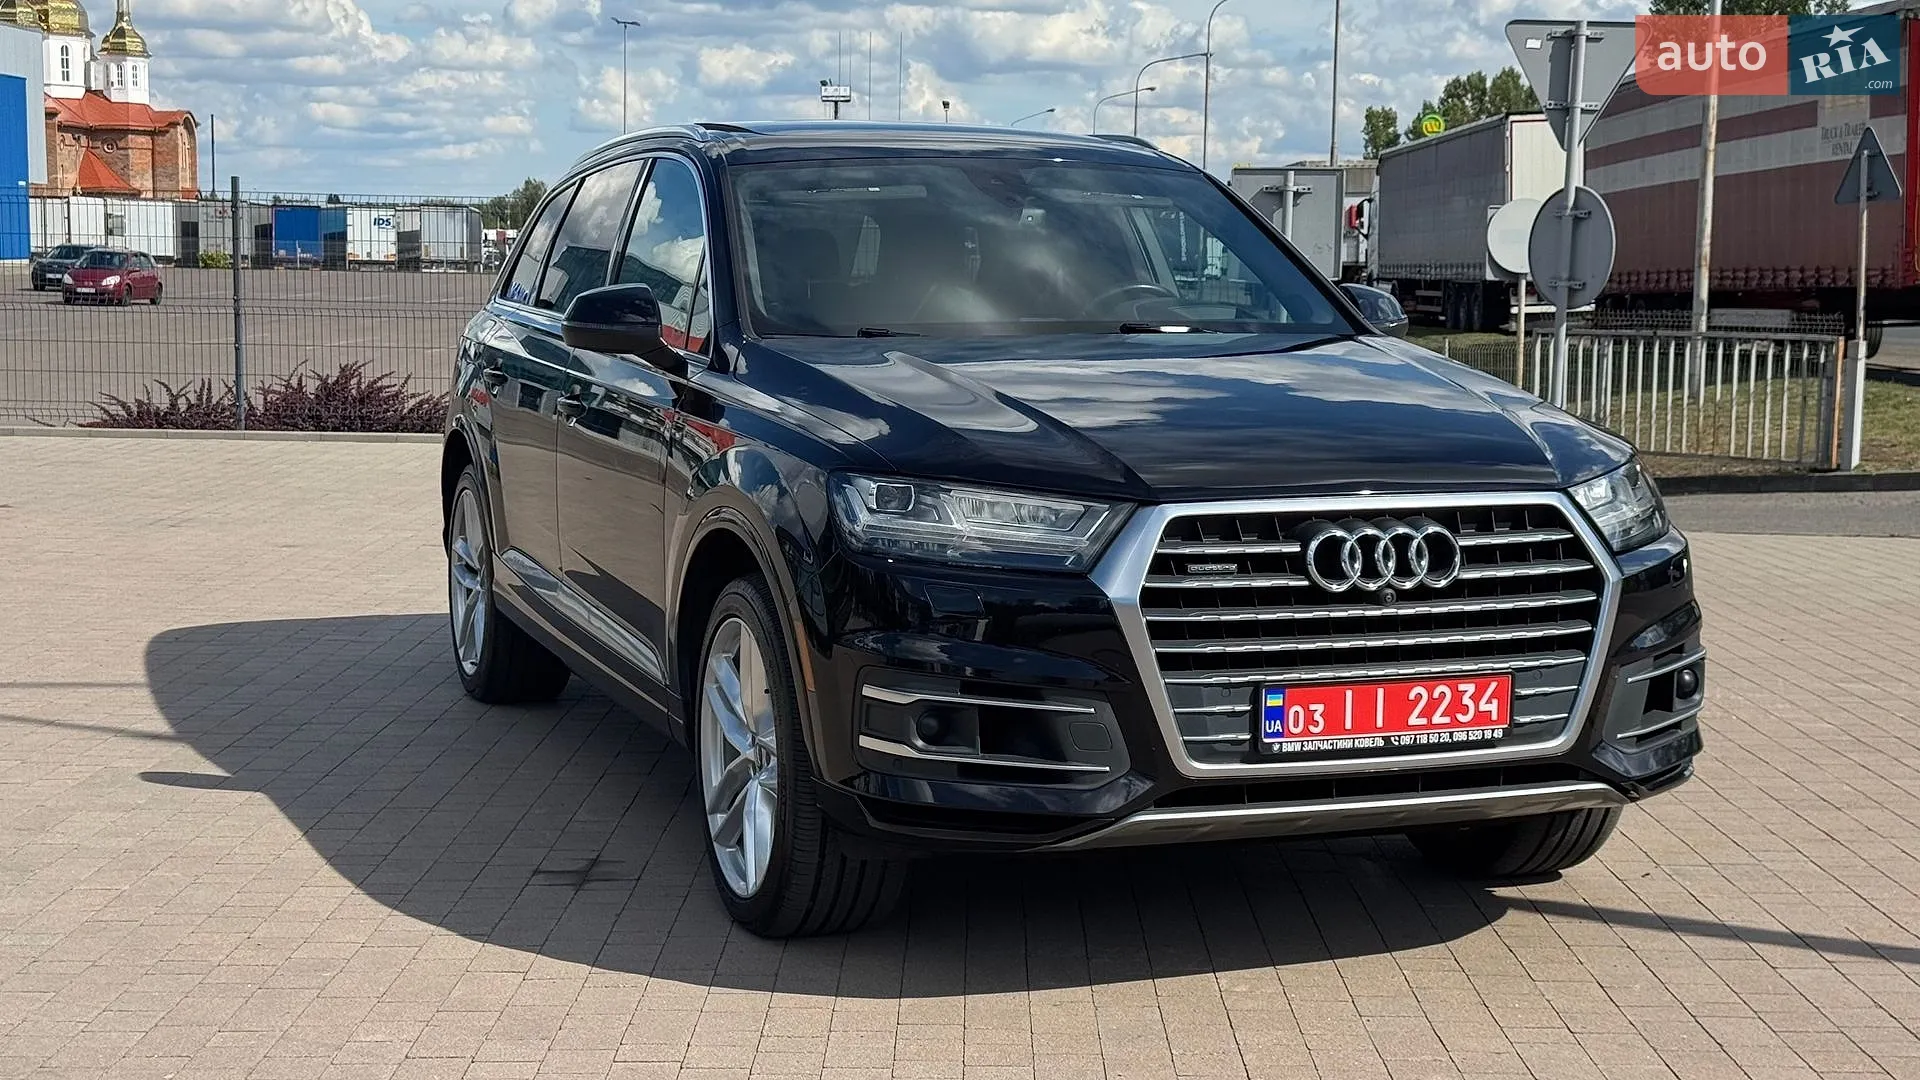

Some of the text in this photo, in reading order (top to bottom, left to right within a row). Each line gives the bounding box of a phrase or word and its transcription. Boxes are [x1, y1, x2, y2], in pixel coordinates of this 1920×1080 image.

[373, 217, 391, 226] IDS
[1288, 703, 1325, 735] 03
[1407, 680, 1500, 727] 2234
[1266, 720, 1283, 734] UA
[1282, 742, 1302, 752] BMW
[1303, 739, 1353, 751] ЗАПЧАСТИНИ
[1354, 737, 1385, 748] КОВЕЛЬ
[1400, 735, 1415, 745] 097
[1453, 731, 1468, 741] 096
[1469, 730, 1482, 740] 520
[1484, 729, 1492, 739] 19
